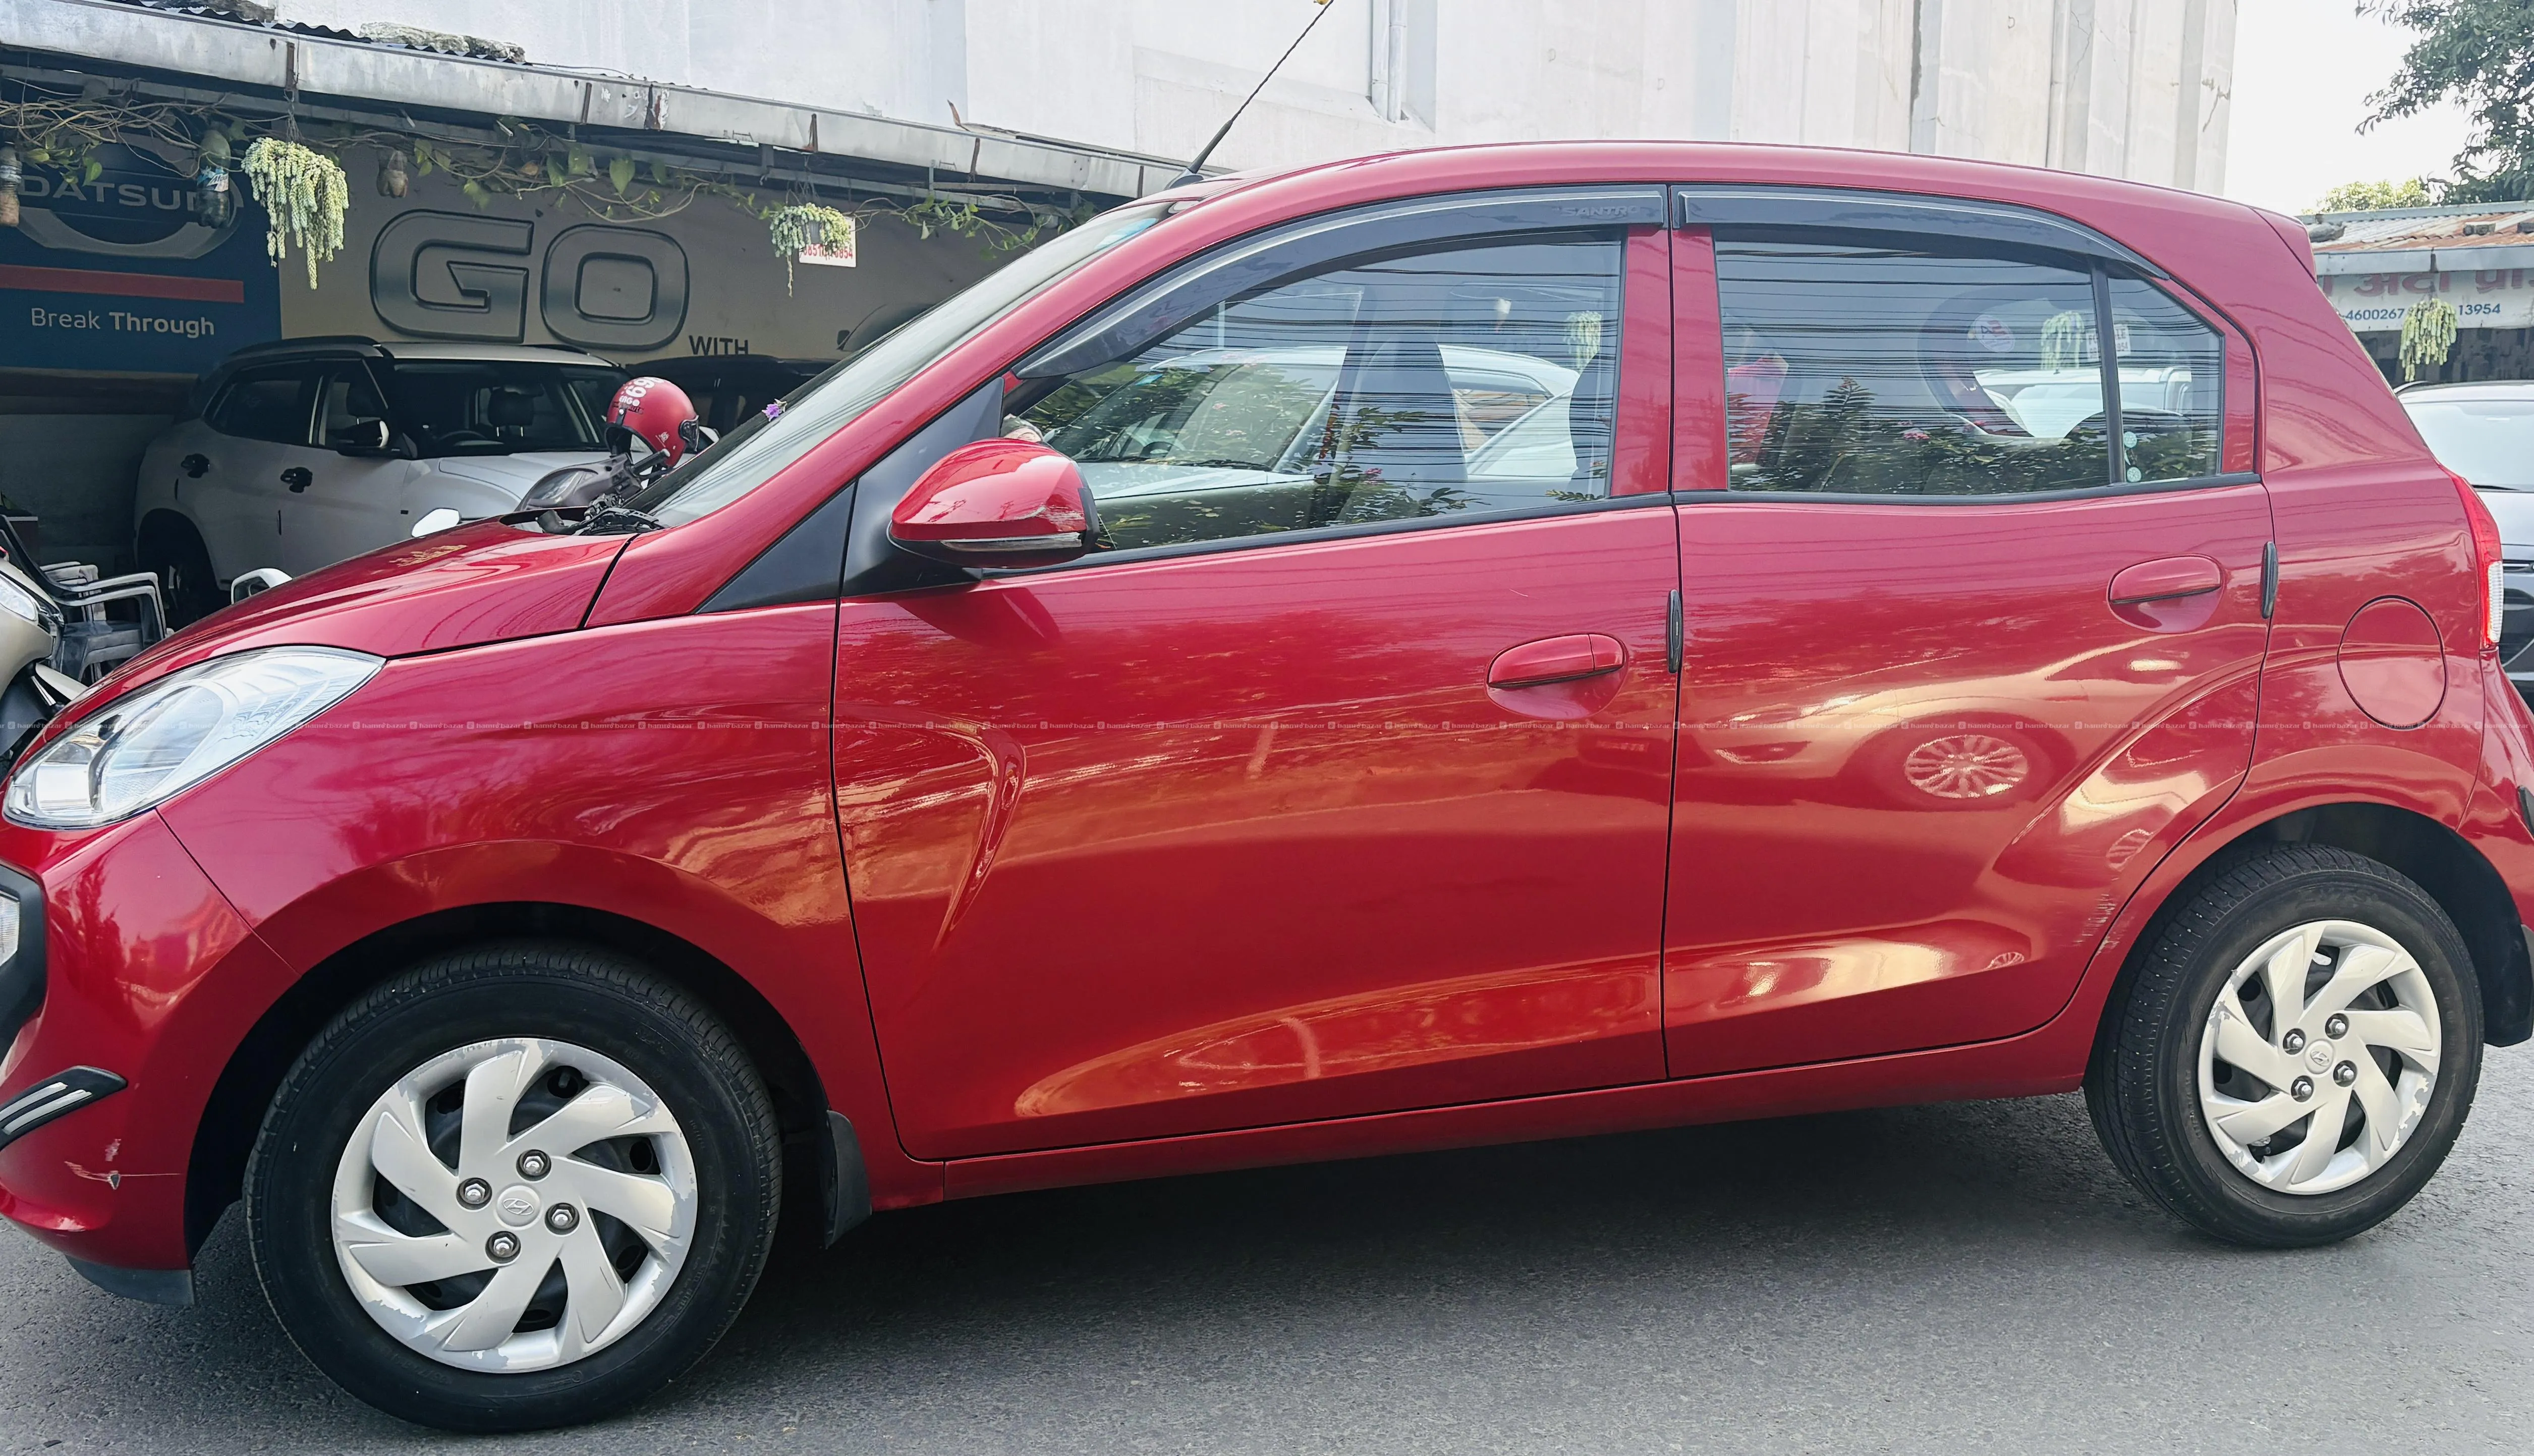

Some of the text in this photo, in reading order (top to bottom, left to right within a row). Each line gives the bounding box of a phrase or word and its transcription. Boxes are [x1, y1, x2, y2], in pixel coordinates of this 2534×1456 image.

[19, 175, 198, 211] DATSU
[369, 208, 690, 352] GO
[31, 308, 215, 339] Break Through
[689, 335, 749, 356] WITH
